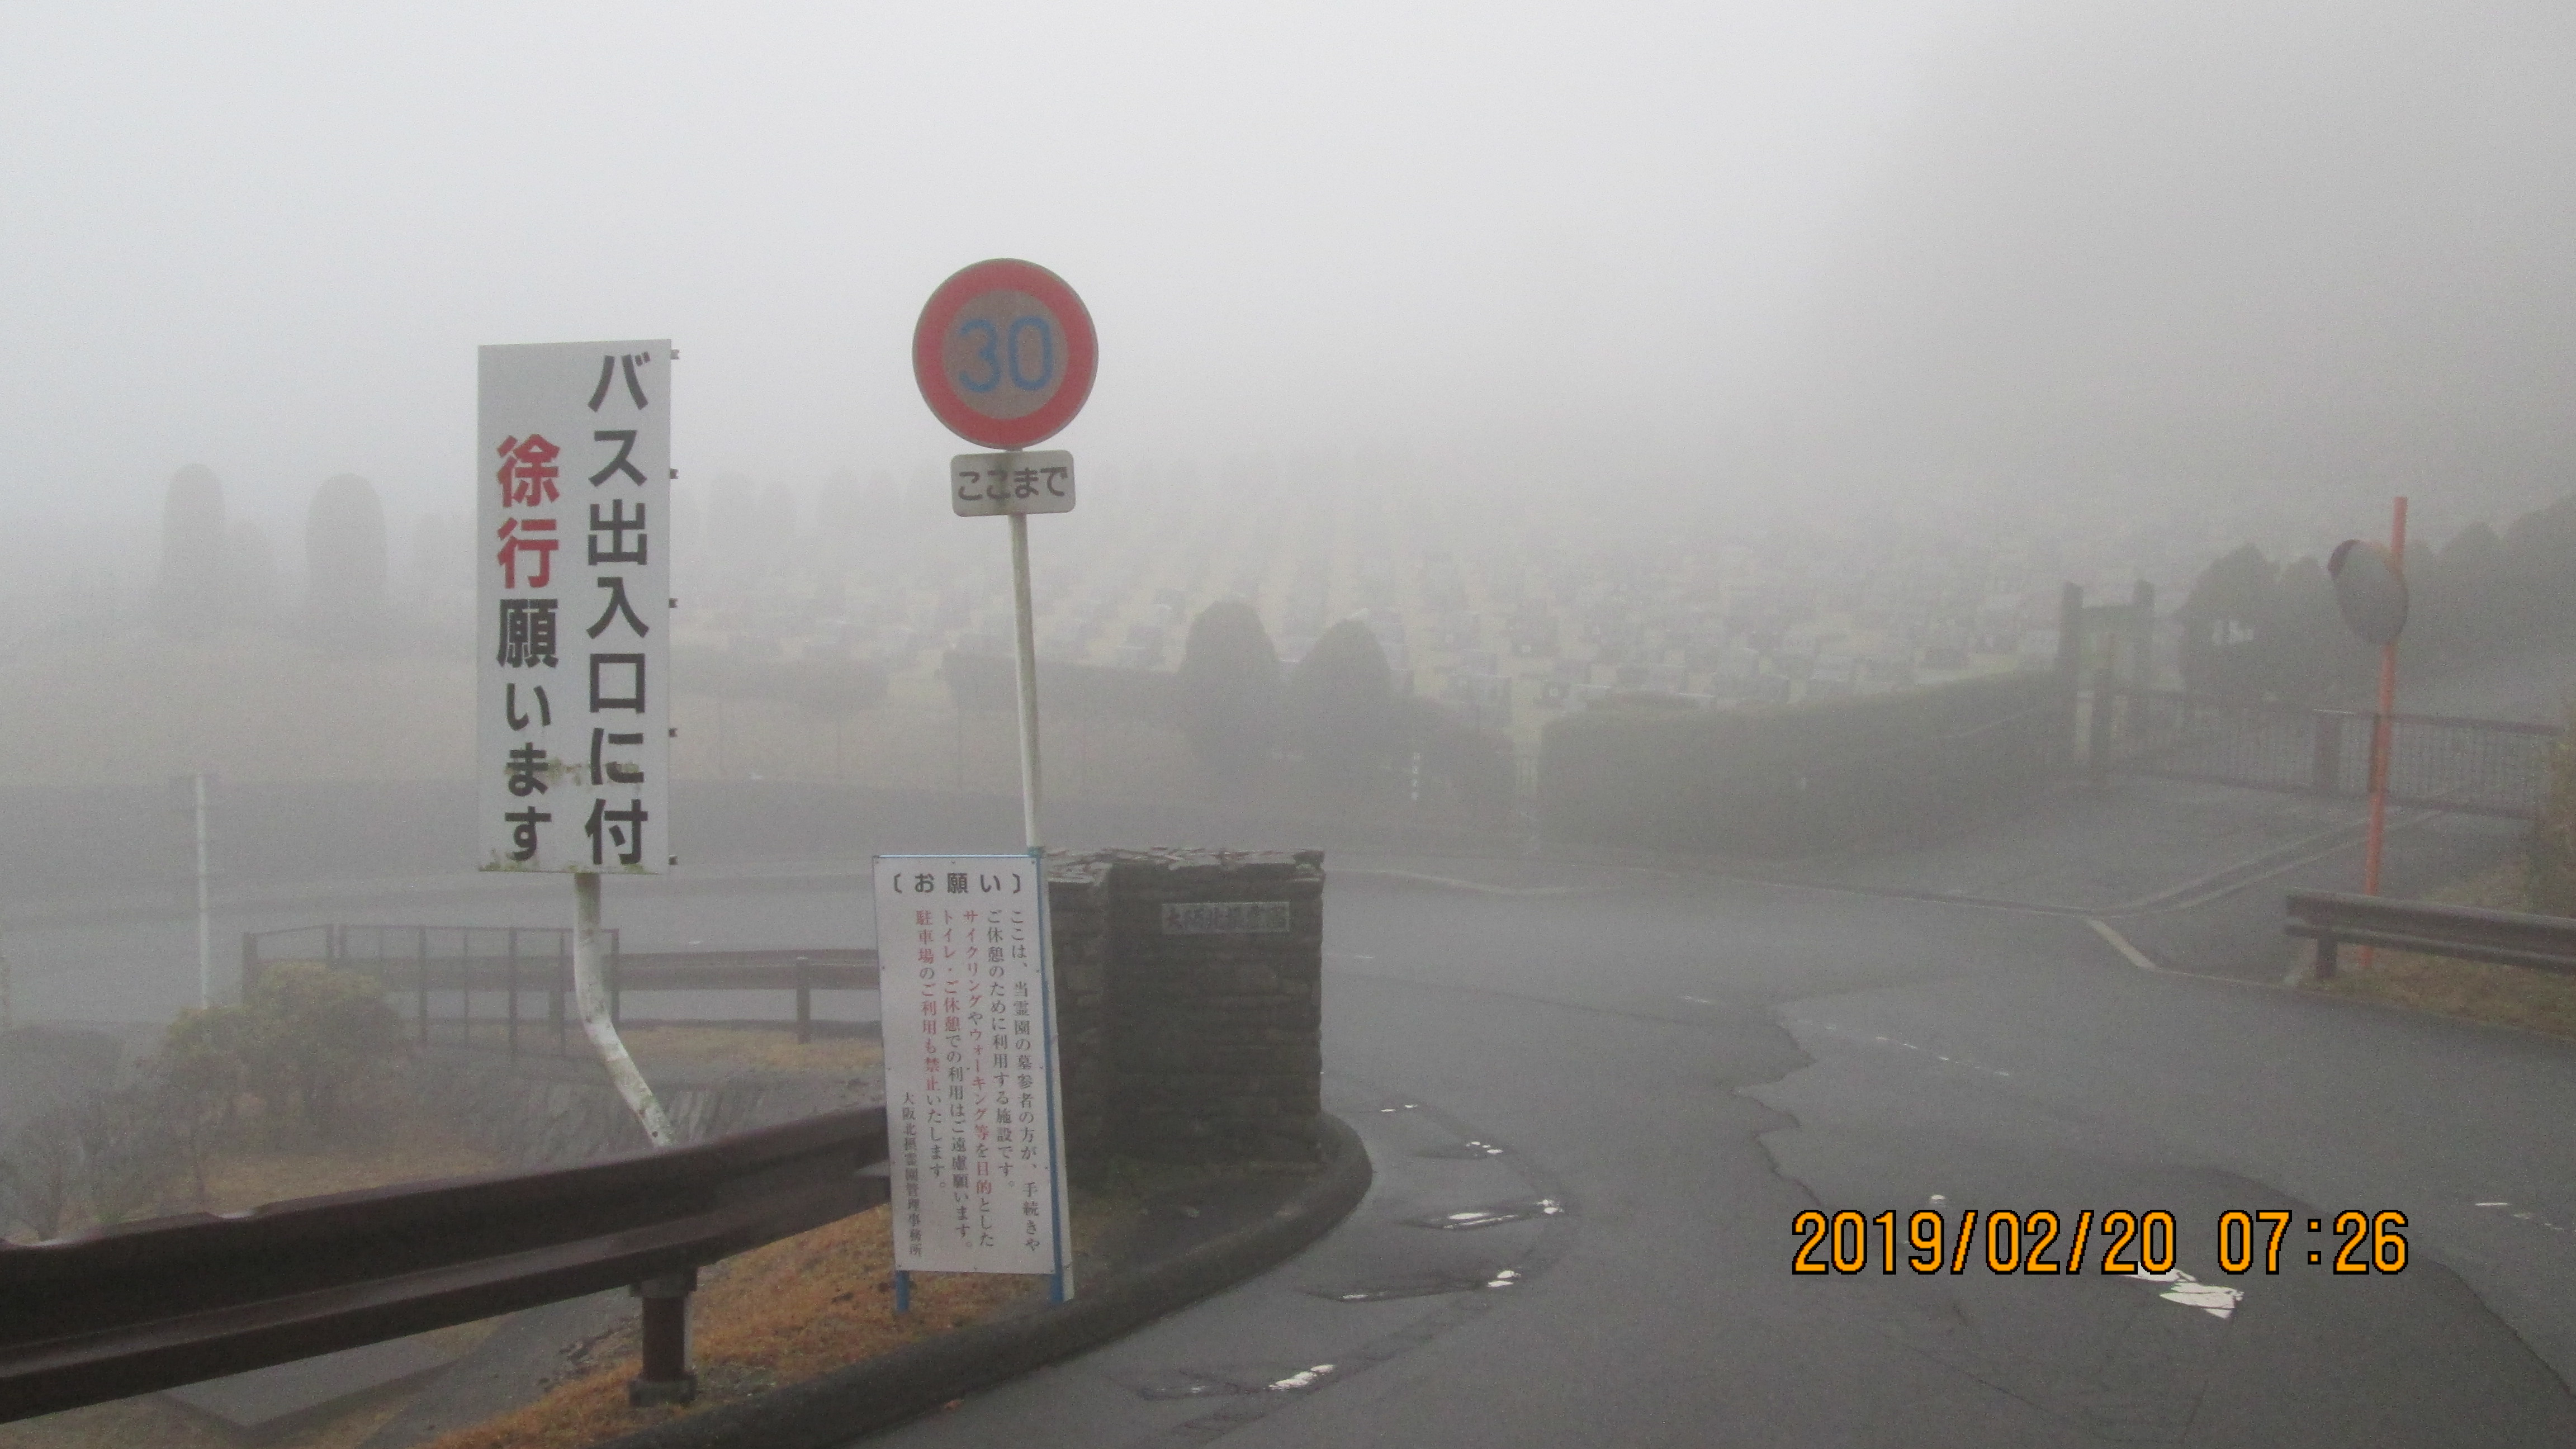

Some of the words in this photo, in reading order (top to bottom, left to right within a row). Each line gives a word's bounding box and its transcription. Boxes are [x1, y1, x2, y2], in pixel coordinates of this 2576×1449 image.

[959, 315, 1054, 393] 30
[585, 351, 650, 866] バス出入口に付
[958, 466, 1068, 501] ここまで
[496, 434, 560, 863] 徐行願います
